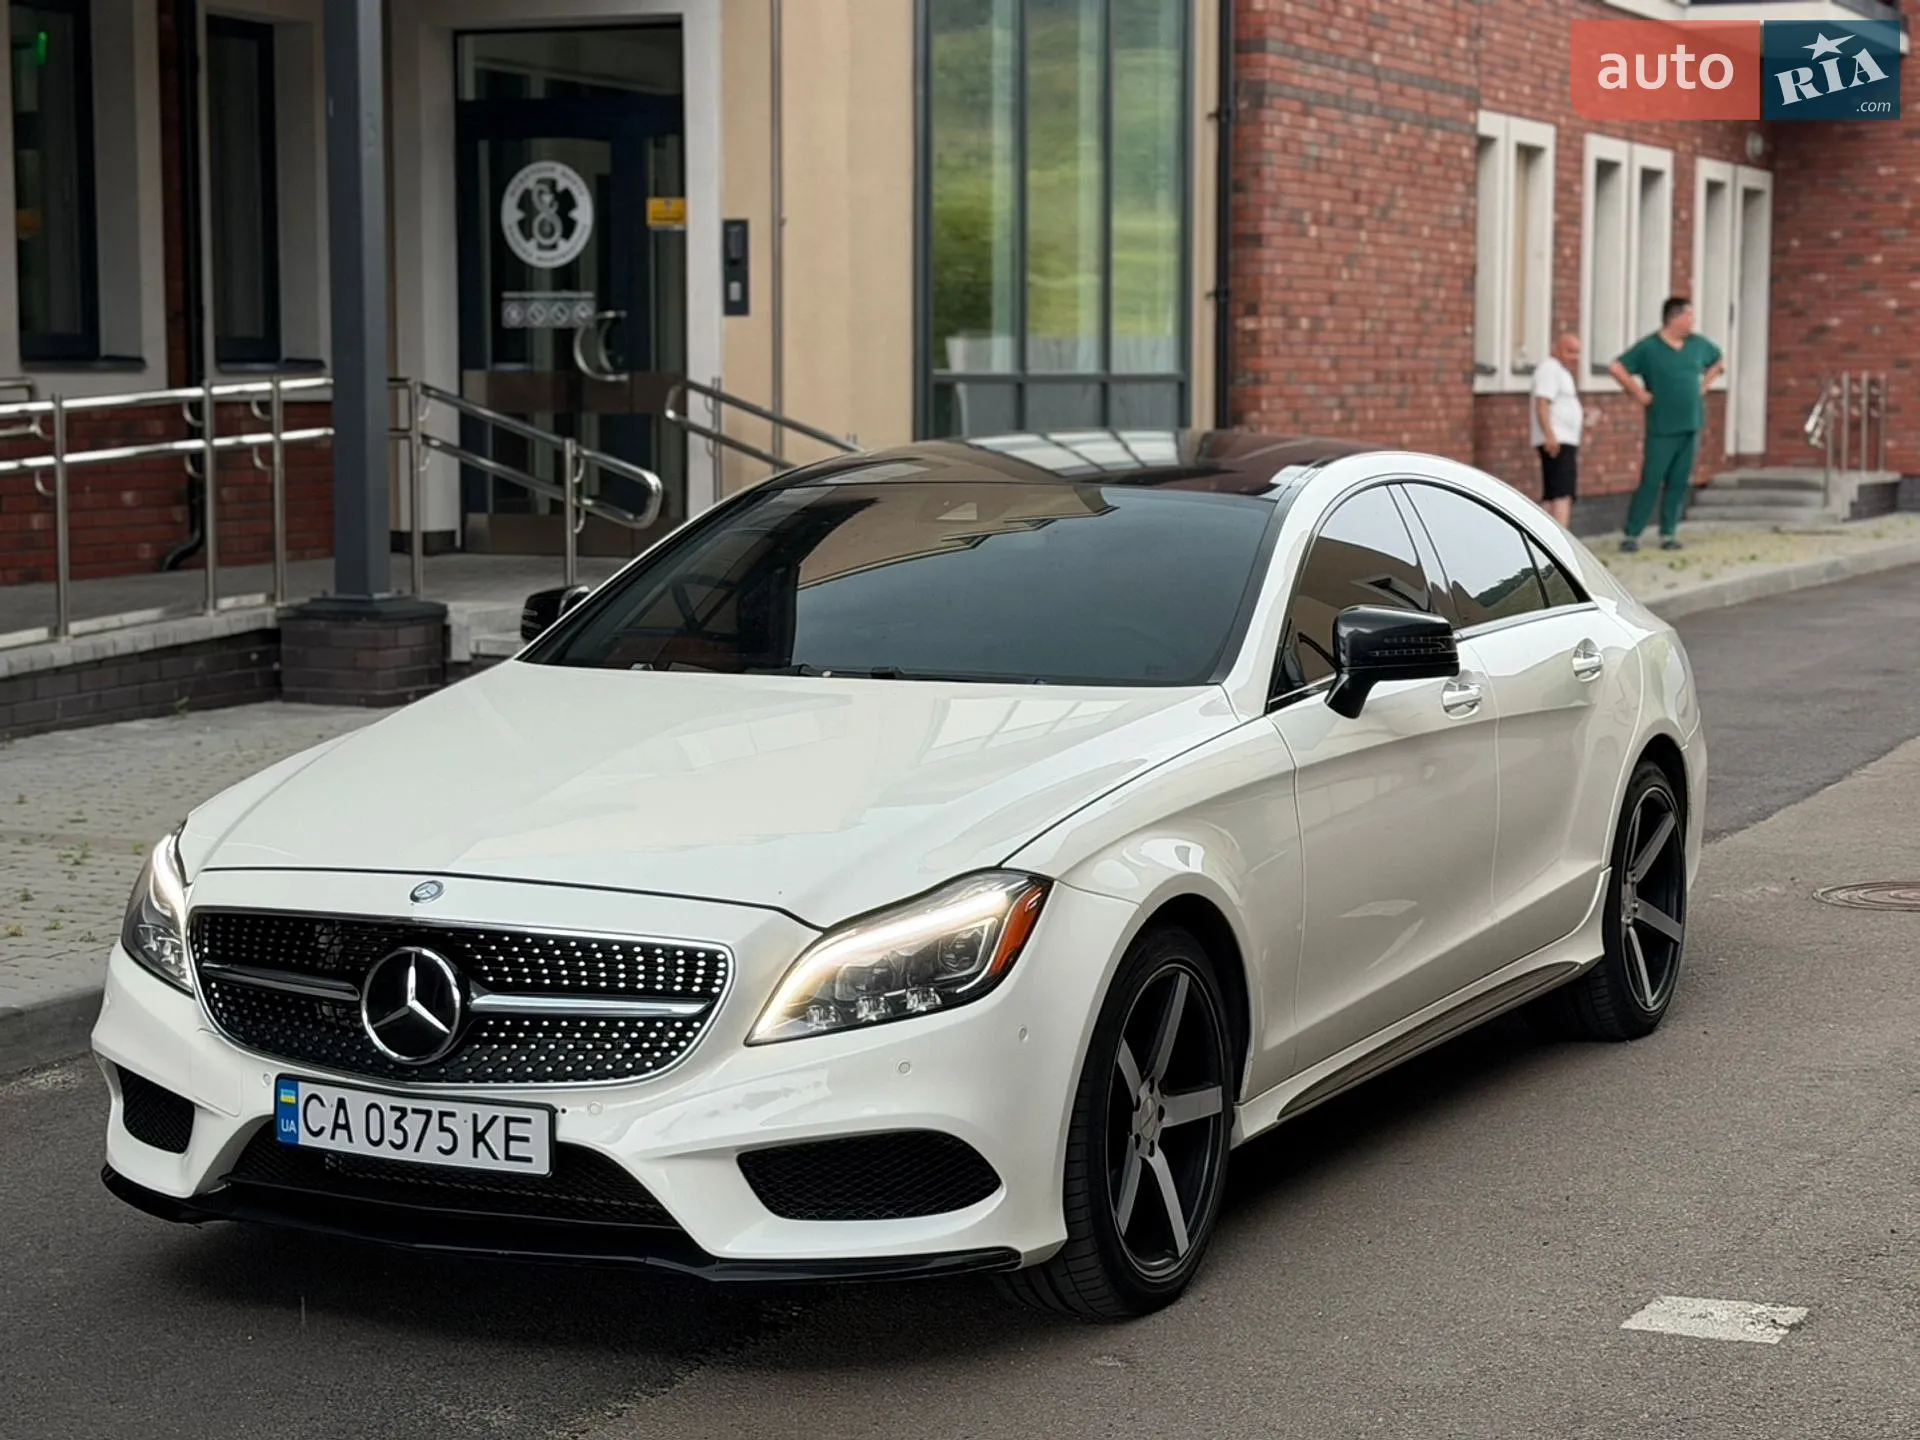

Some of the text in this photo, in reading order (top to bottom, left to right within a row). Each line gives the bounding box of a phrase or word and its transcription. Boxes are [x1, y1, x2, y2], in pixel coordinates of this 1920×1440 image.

[281, 1118, 297, 1134] UA
[302, 1093, 533, 1163] CA 0375 KE
